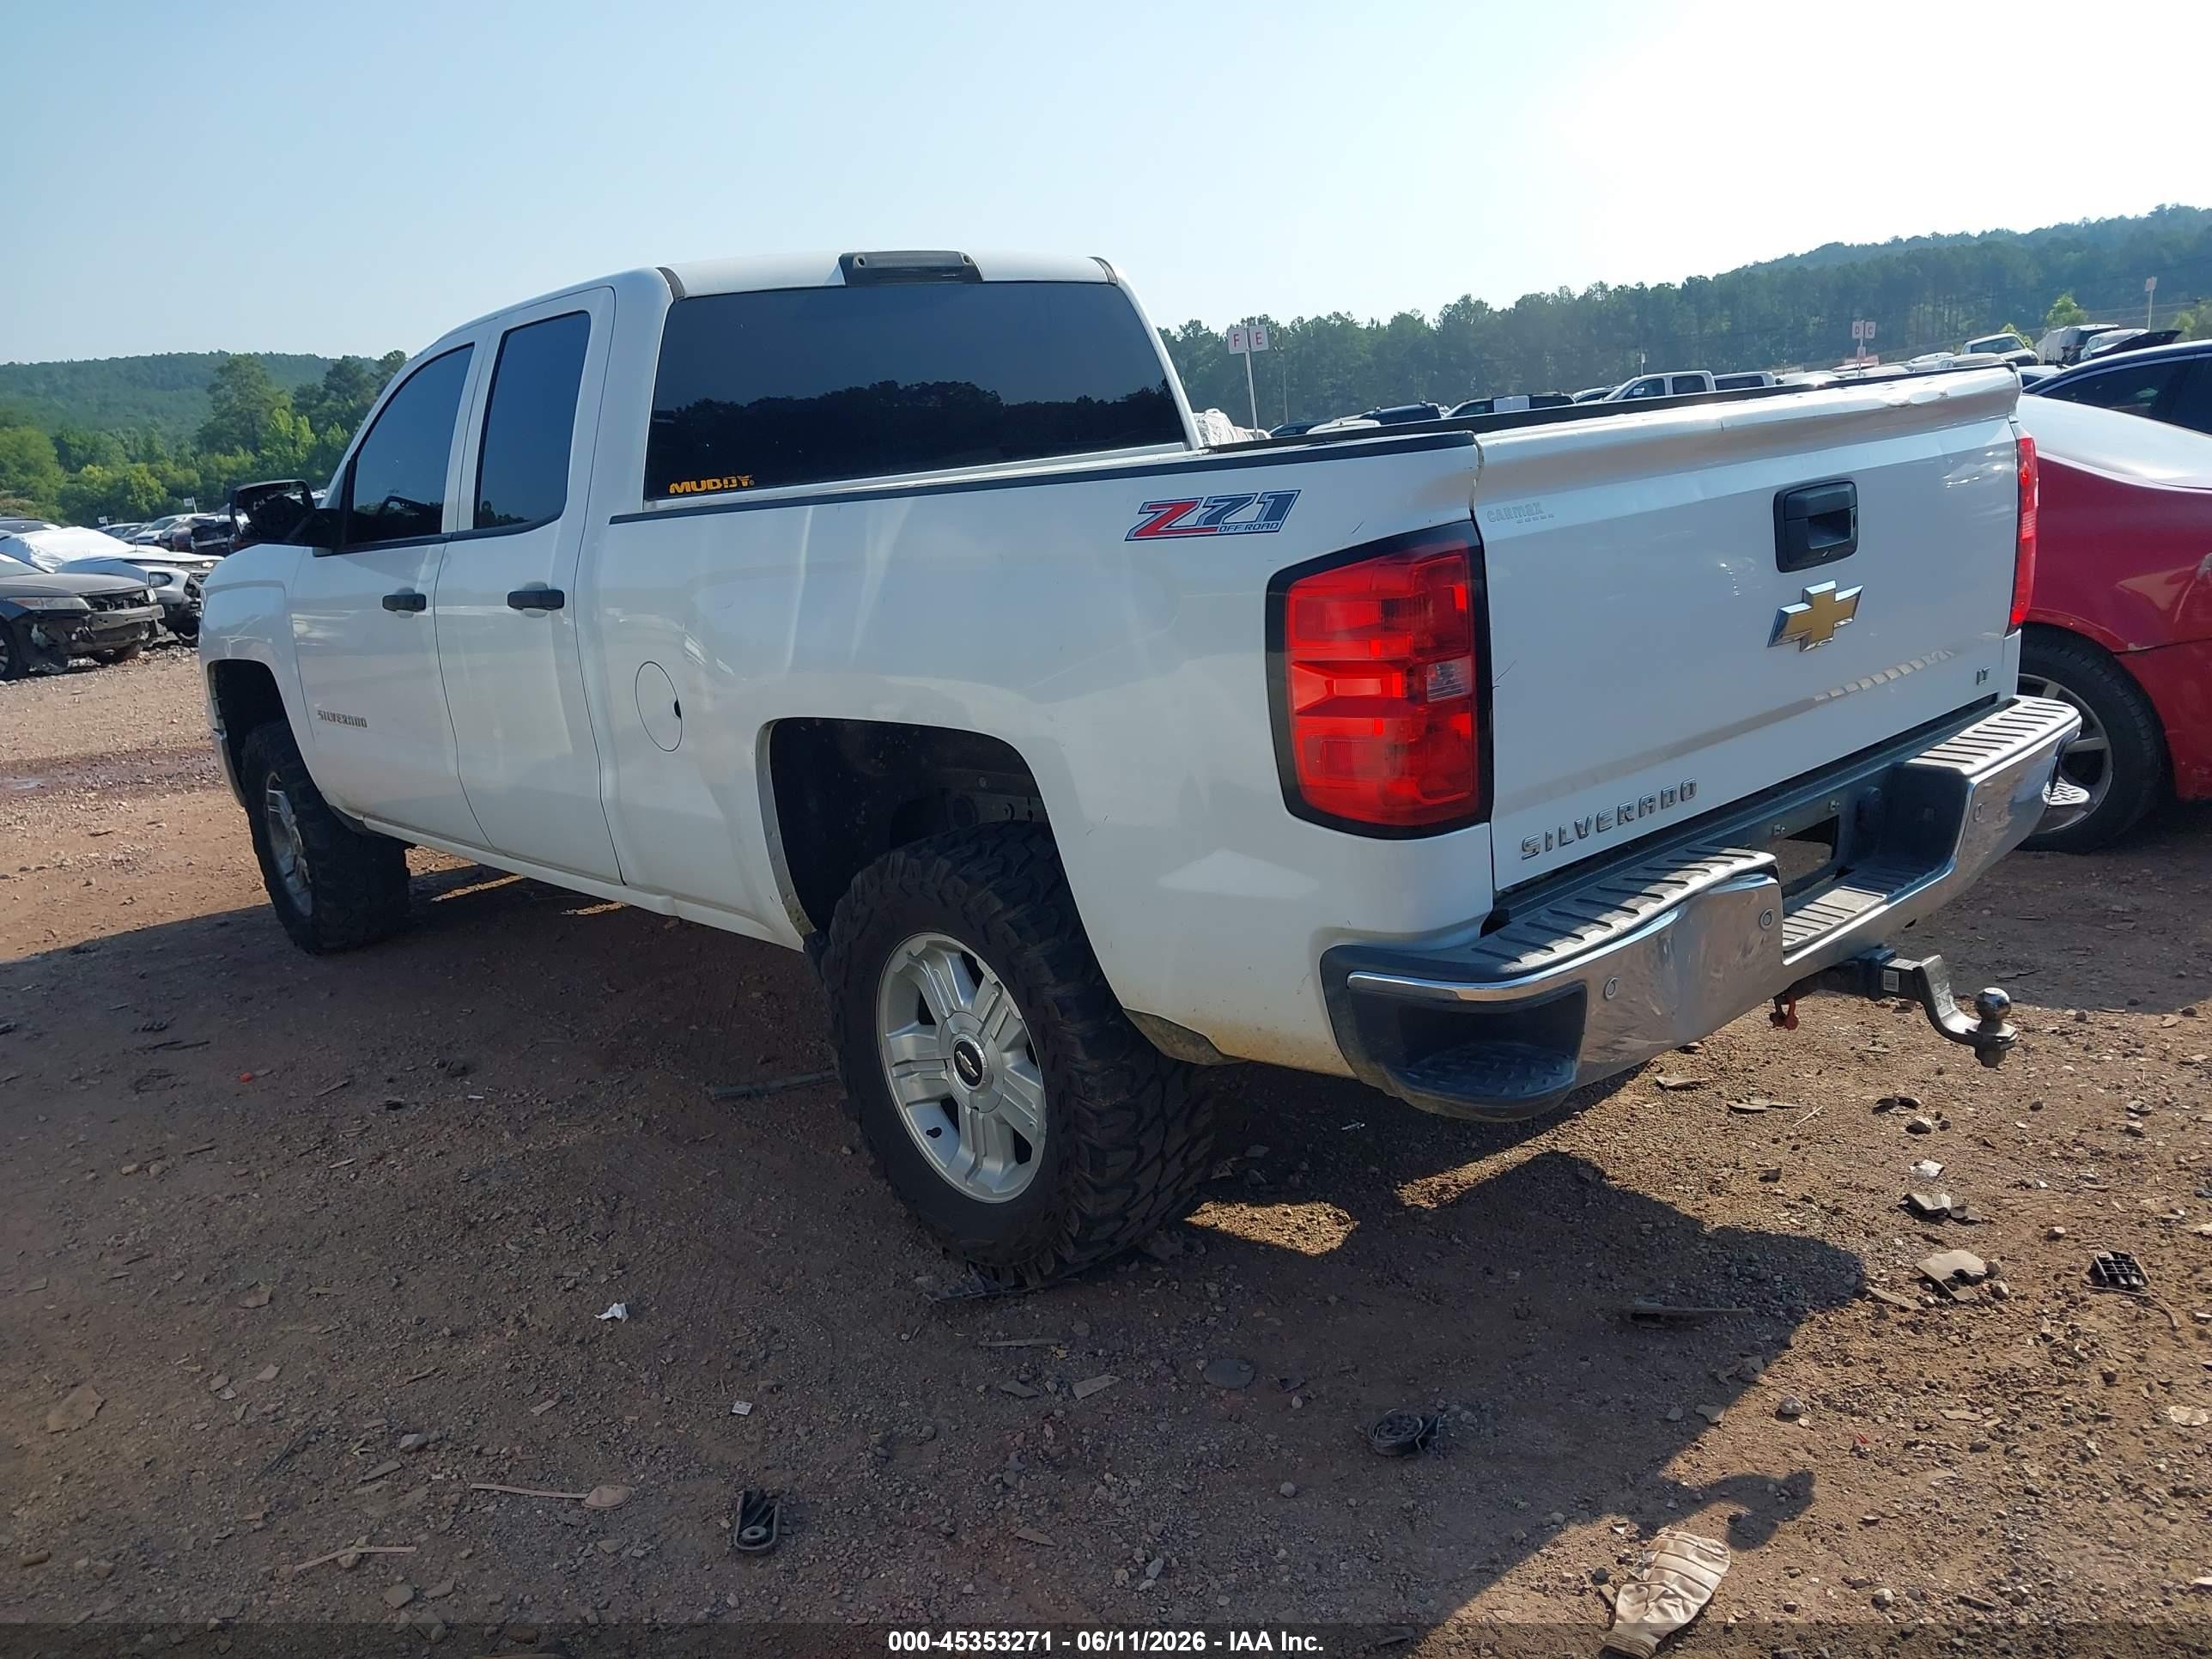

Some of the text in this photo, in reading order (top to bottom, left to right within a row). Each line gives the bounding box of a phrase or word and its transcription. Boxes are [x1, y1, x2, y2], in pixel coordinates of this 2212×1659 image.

[1233, 333, 1239, 348] F
[1255, 331, 1262, 345] E
[669, 475, 753, 494] MUDDY
[1124, 489, 1302, 542] Z71
[1244, 522, 1279, 531] ROAD
[1521, 777, 1698, 860] SILVERADO
